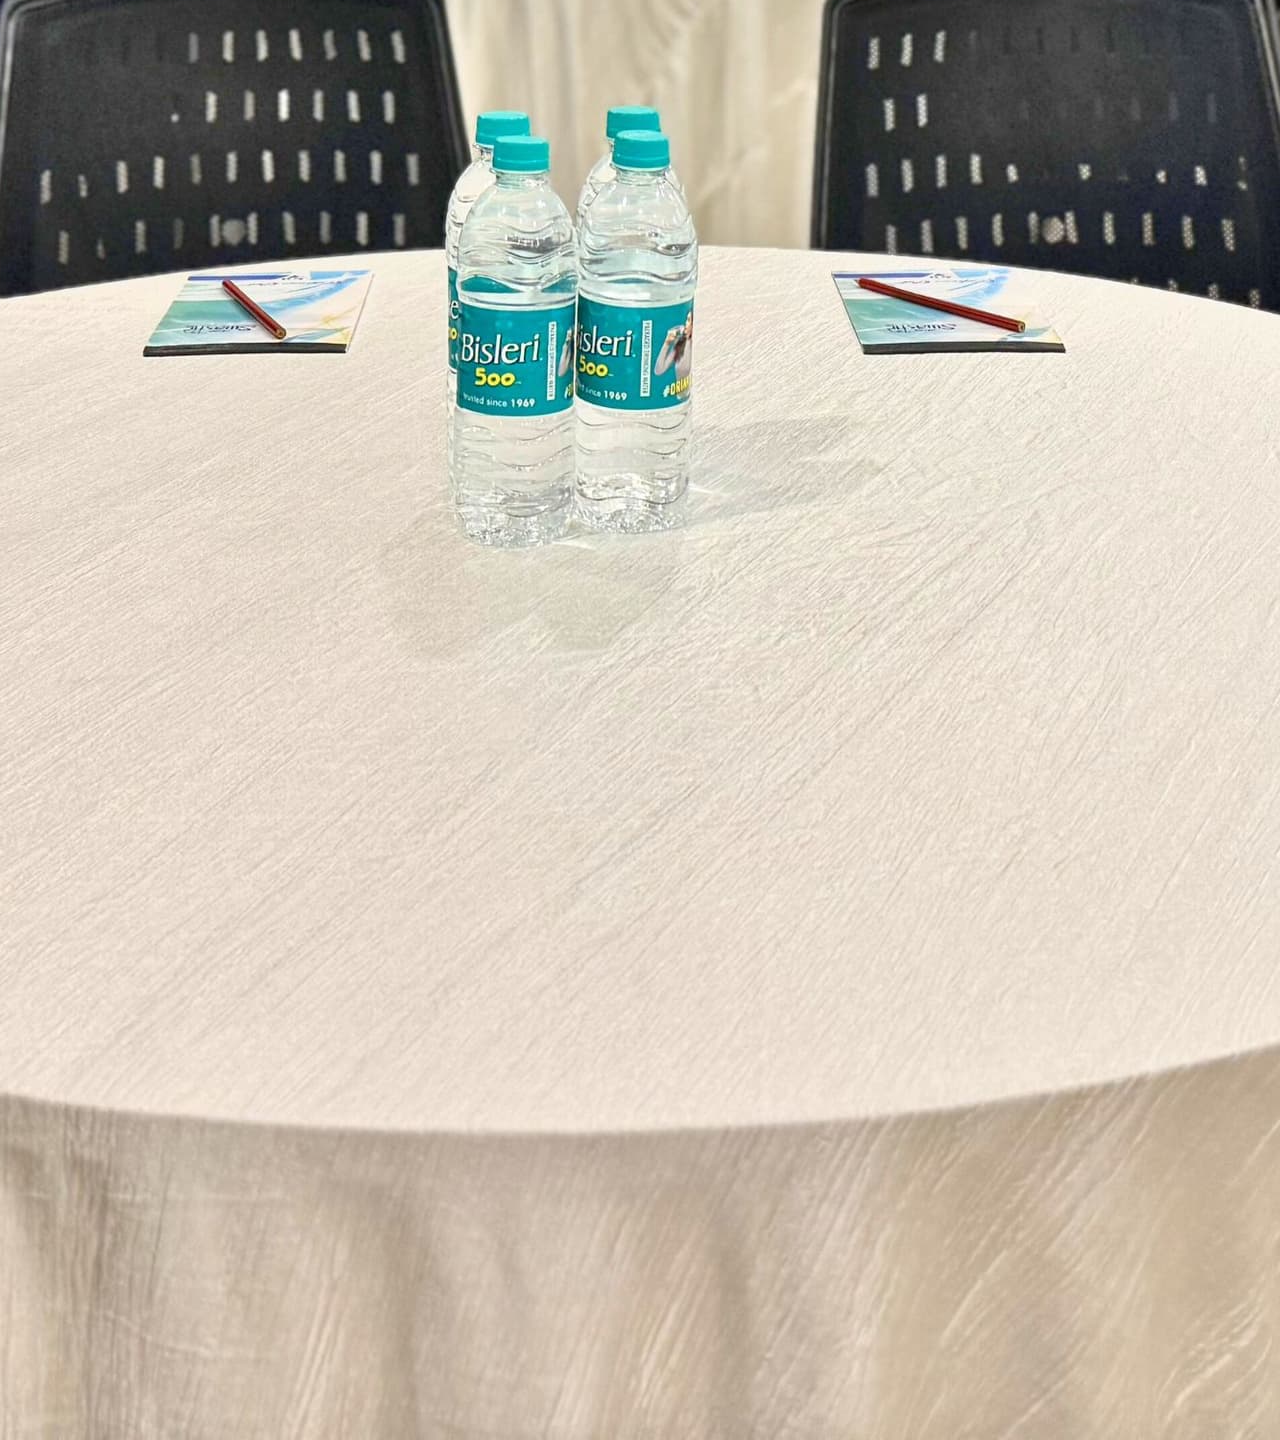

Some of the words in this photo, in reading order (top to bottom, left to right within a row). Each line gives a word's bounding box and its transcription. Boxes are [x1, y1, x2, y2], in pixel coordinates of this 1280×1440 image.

[461, 333, 540, 364] Bisleri
[577, 323, 633, 356] isleri
[579, 355, 609, 377] 500
[475, 367, 516, 386] 500
[486, 397, 508, 407] since
[511, 398, 536, 408] 1969
[604, 390, 627, 401] 1969
